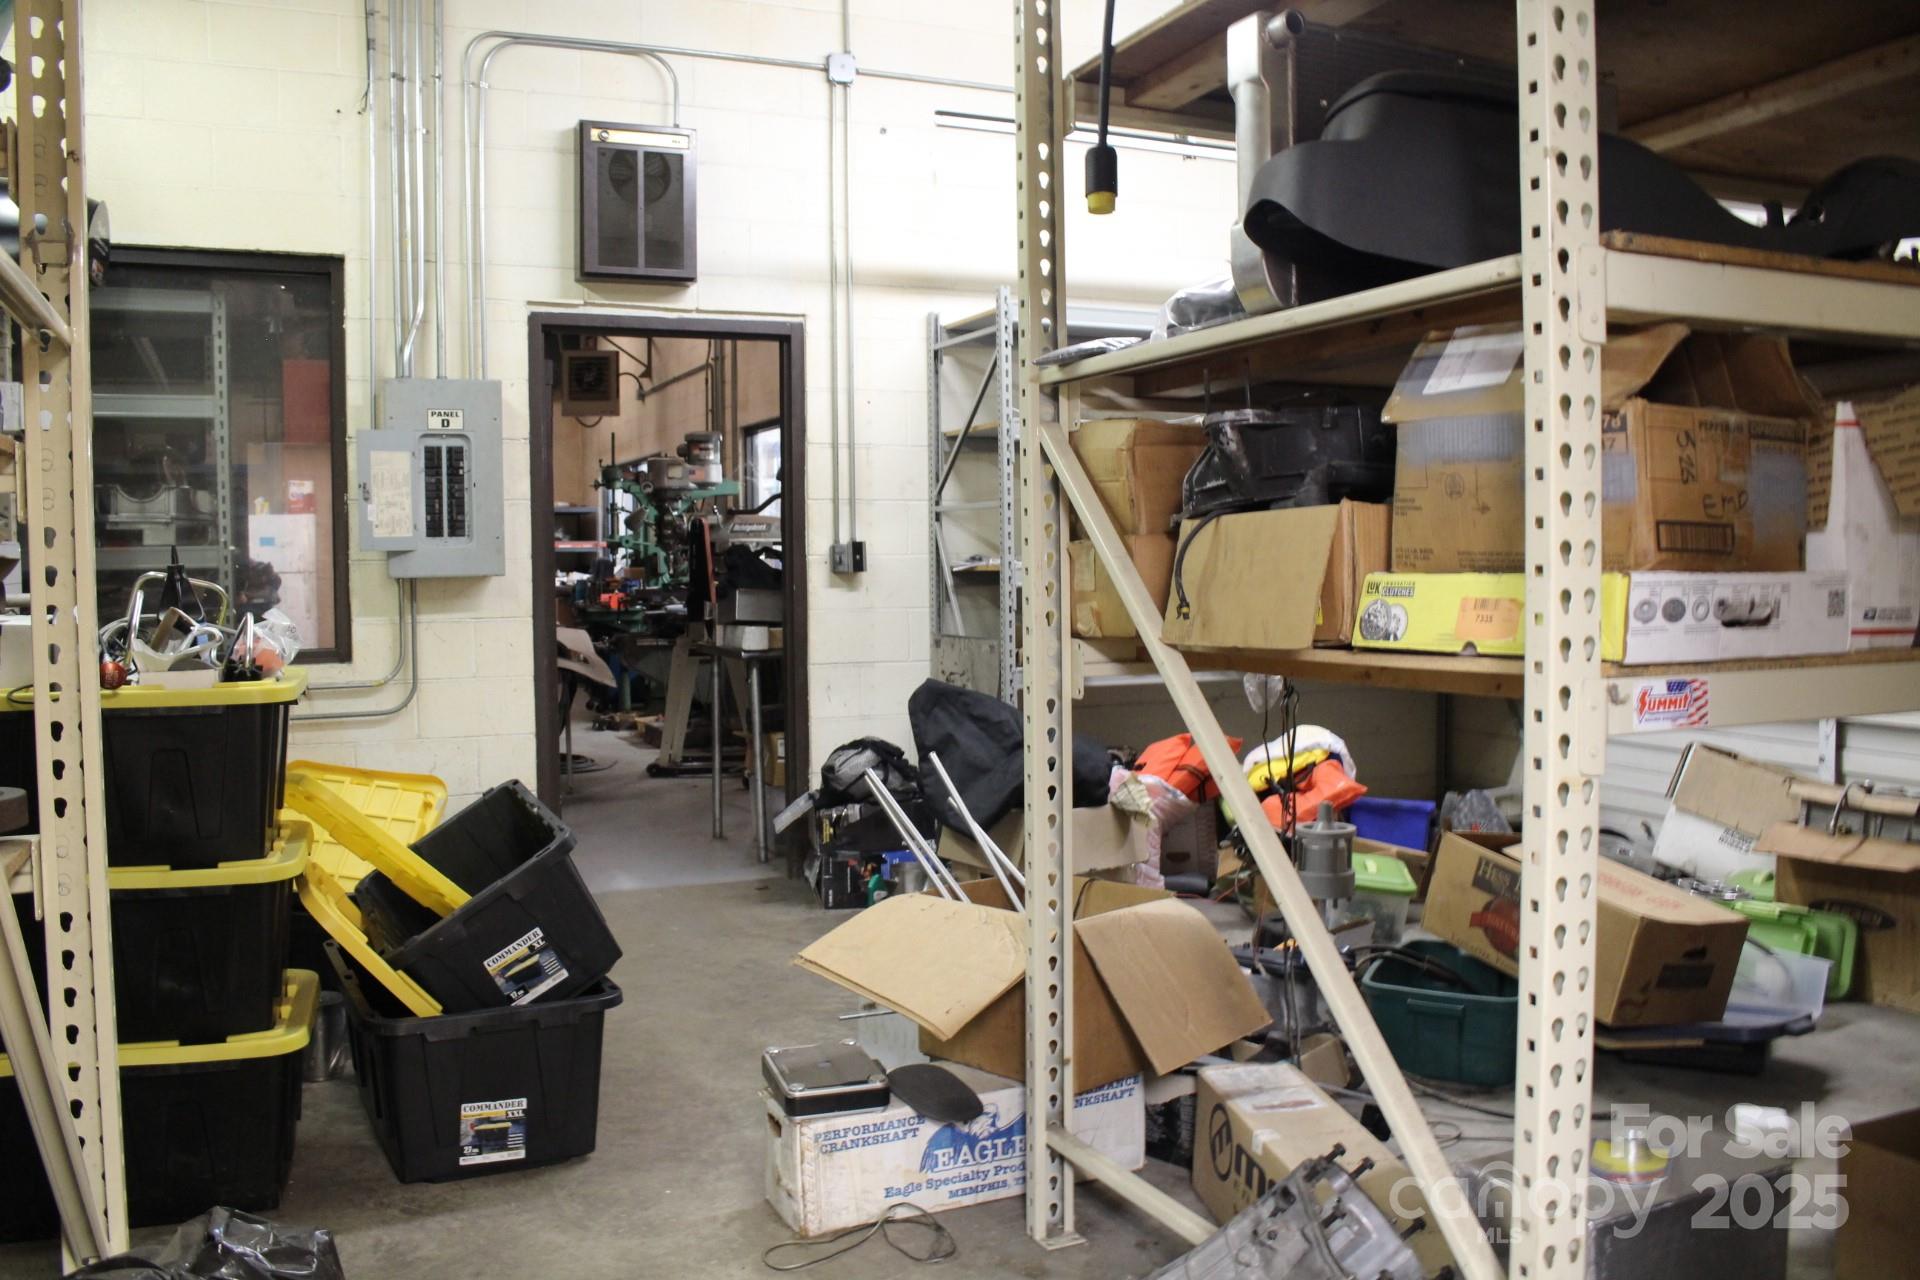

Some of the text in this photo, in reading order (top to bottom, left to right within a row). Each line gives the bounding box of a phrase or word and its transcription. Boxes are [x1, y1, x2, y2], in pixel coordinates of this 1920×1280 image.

[441, 418, 450, 428] D
[1638, 685, 1692, 723] SUMMIT
[486, 930, 540, 968] COMMANDER
[463, 1100, 524, 1113] COMMANDER
[1073, 1086, 1136, 1109] NKSHAFT
[814, 1114, 926, 1143] PERFORMANCE
[819, 1127, 920, 1155] CRANKSHAFT
[932, 1134, 1026, 1172] EAGLE
[884, 1163, 1026, 1199] Eagle Specialty Prod
